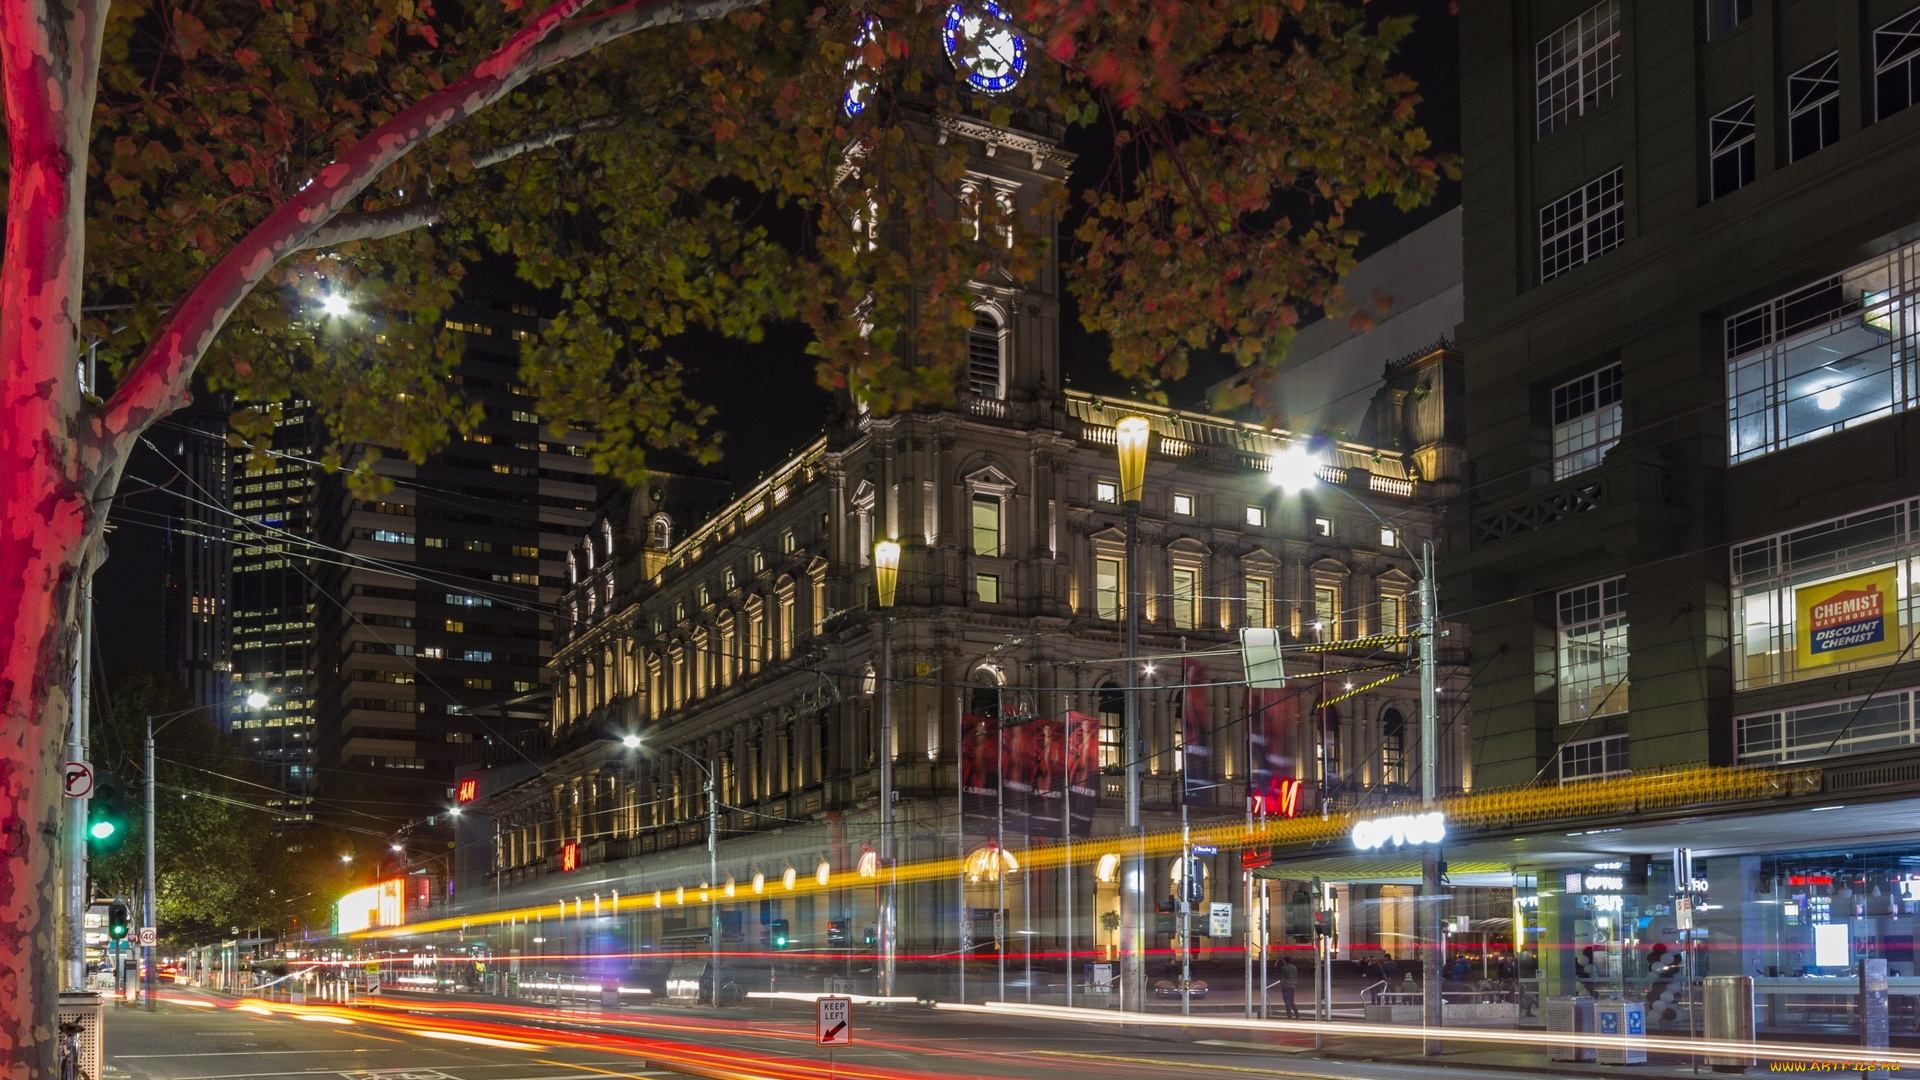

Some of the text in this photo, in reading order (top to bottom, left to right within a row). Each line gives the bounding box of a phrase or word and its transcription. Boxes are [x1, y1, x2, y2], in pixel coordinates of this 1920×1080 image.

[1814, 594, 1879, 620] CHEMIST
[1815, 608, 1880, 627] WAREHOUSE
[1816, 620, 1880, 641] DISCOUNT
[1821, 631, 1874, 649] CHEMIST
[1352, 812, 1446, 850] OPTUS
[1585, 876, 1624, 890] OPTUS
[824, 1002, 845, 1011] KEEP
[825, 1012, 844, 1020] LEFT
